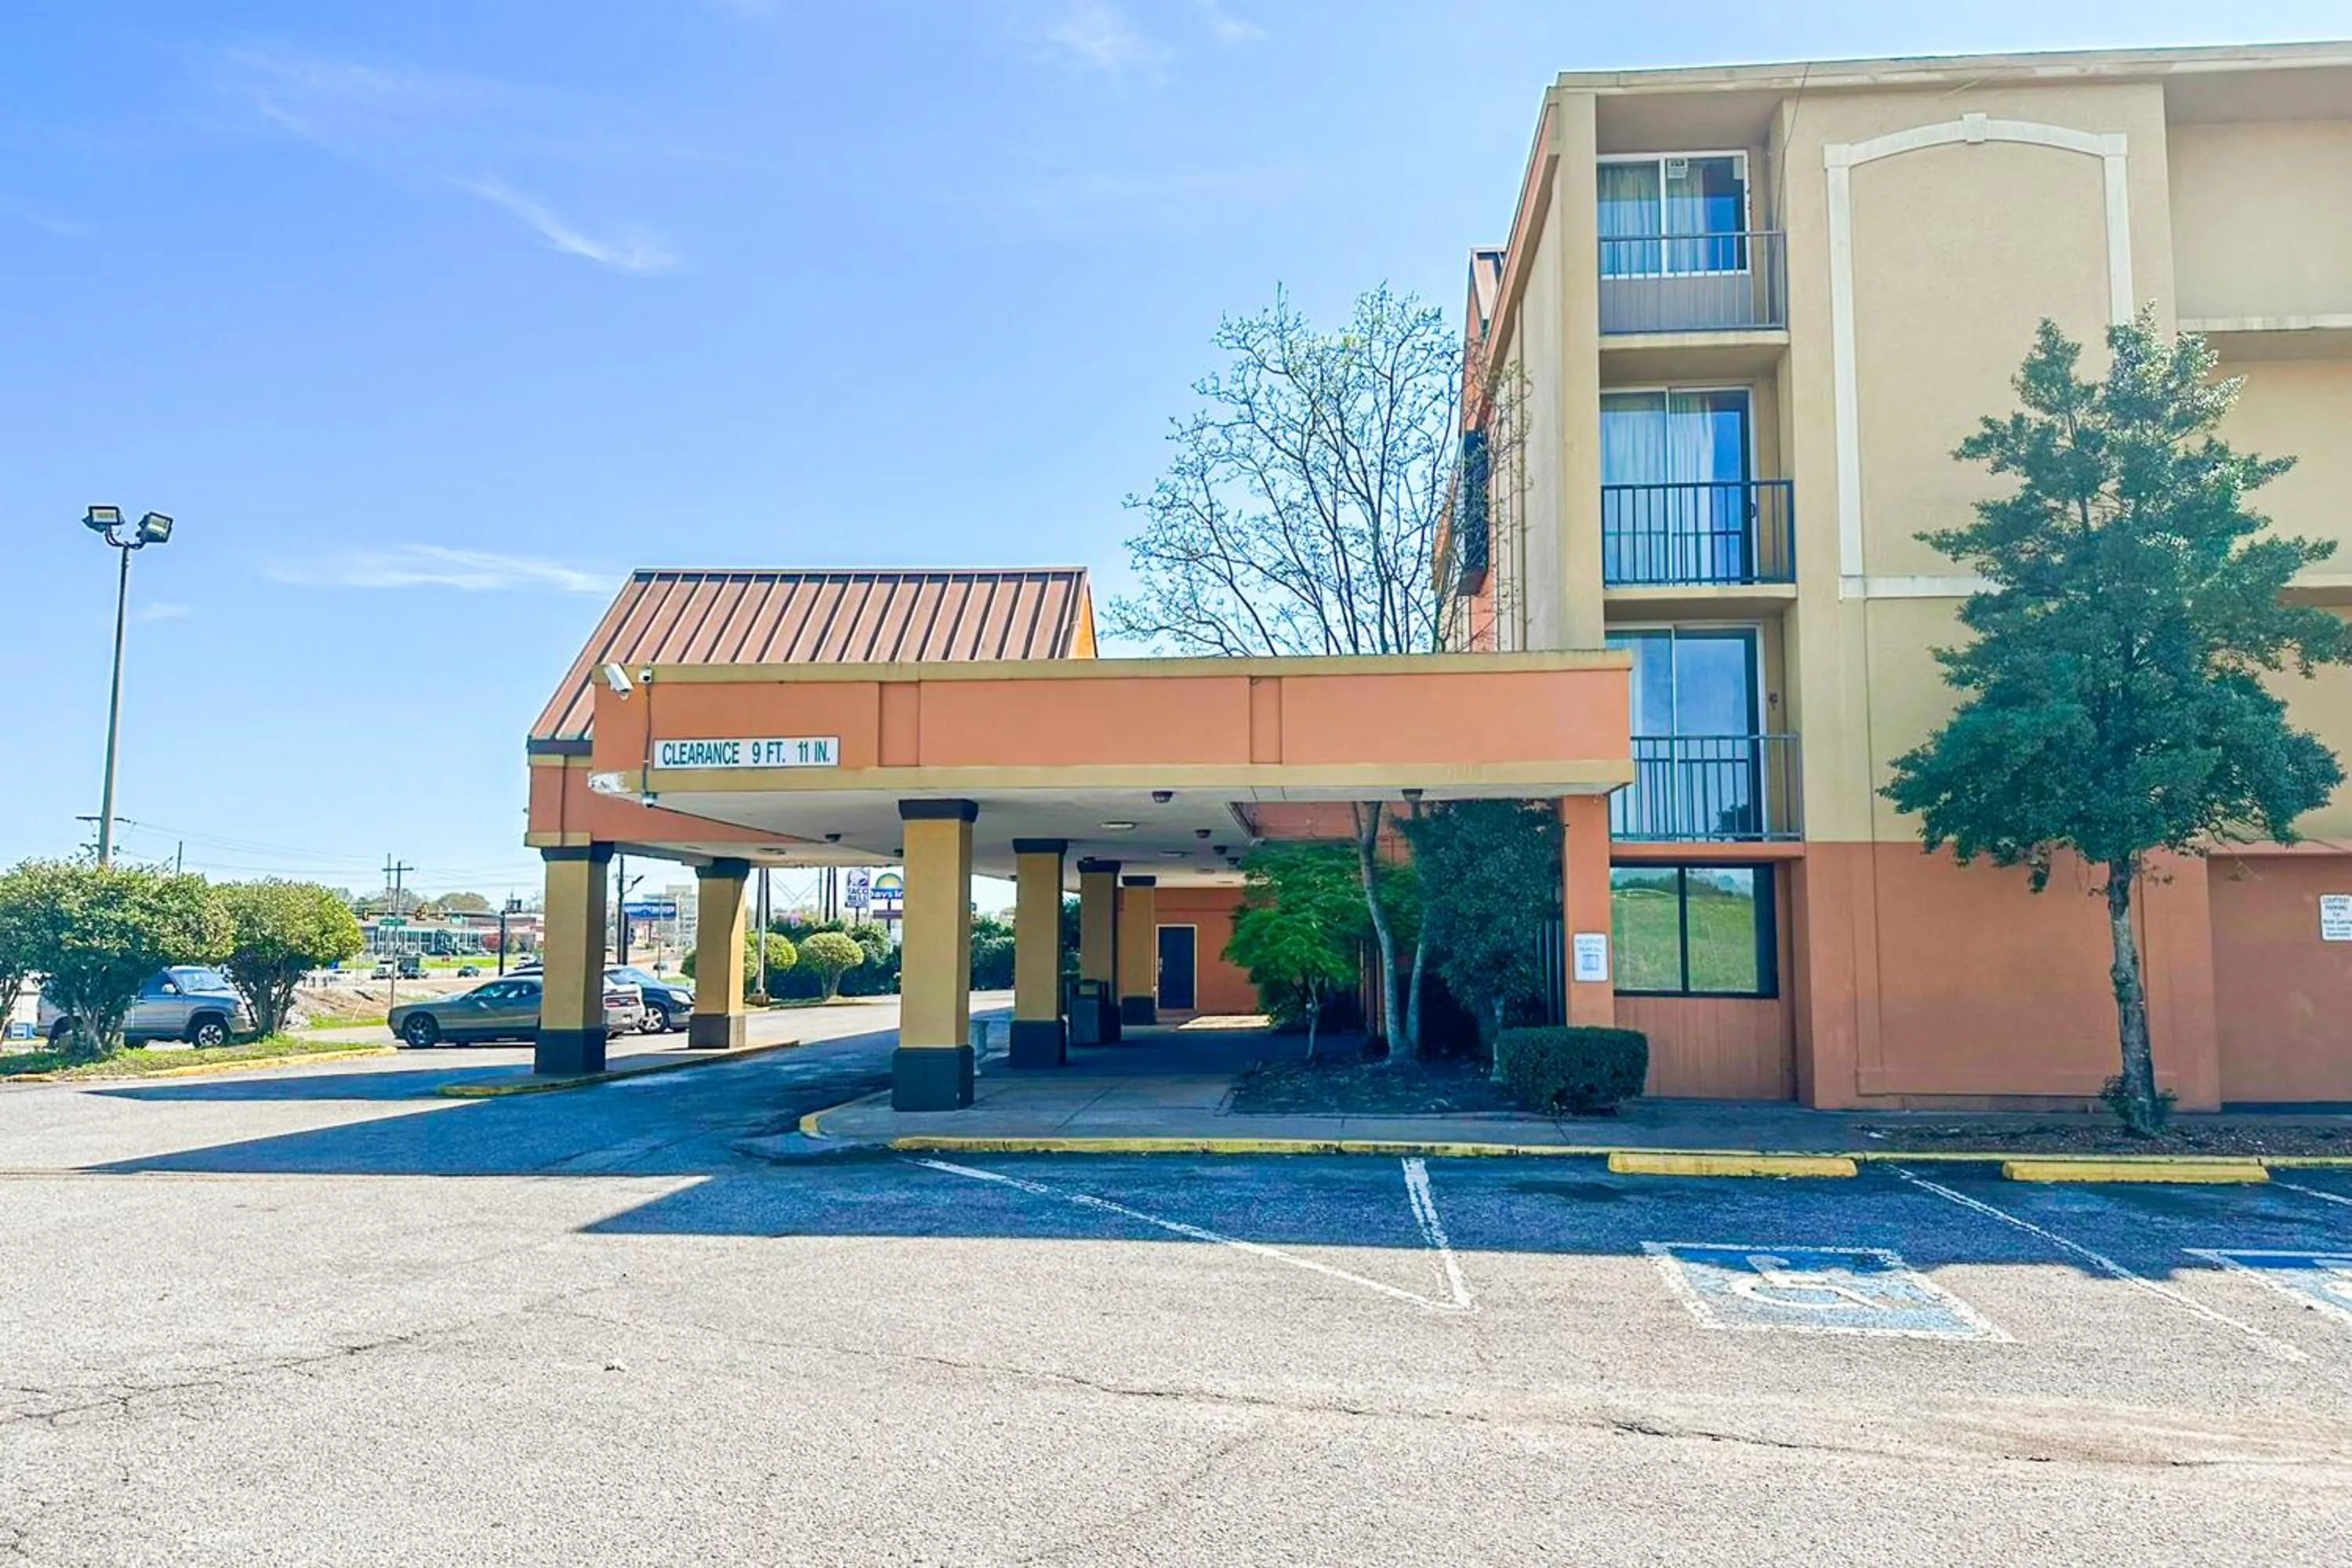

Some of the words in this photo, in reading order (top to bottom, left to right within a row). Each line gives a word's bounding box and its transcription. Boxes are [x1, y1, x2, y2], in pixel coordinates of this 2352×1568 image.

[662, 742, 739, 765] CLEARANCE
[752, 742, 760, 764] 9
[766, 742, 786, 763] FT.
[797, 742, 808, 762] 11
[815, 741, 830, 762] IN.
